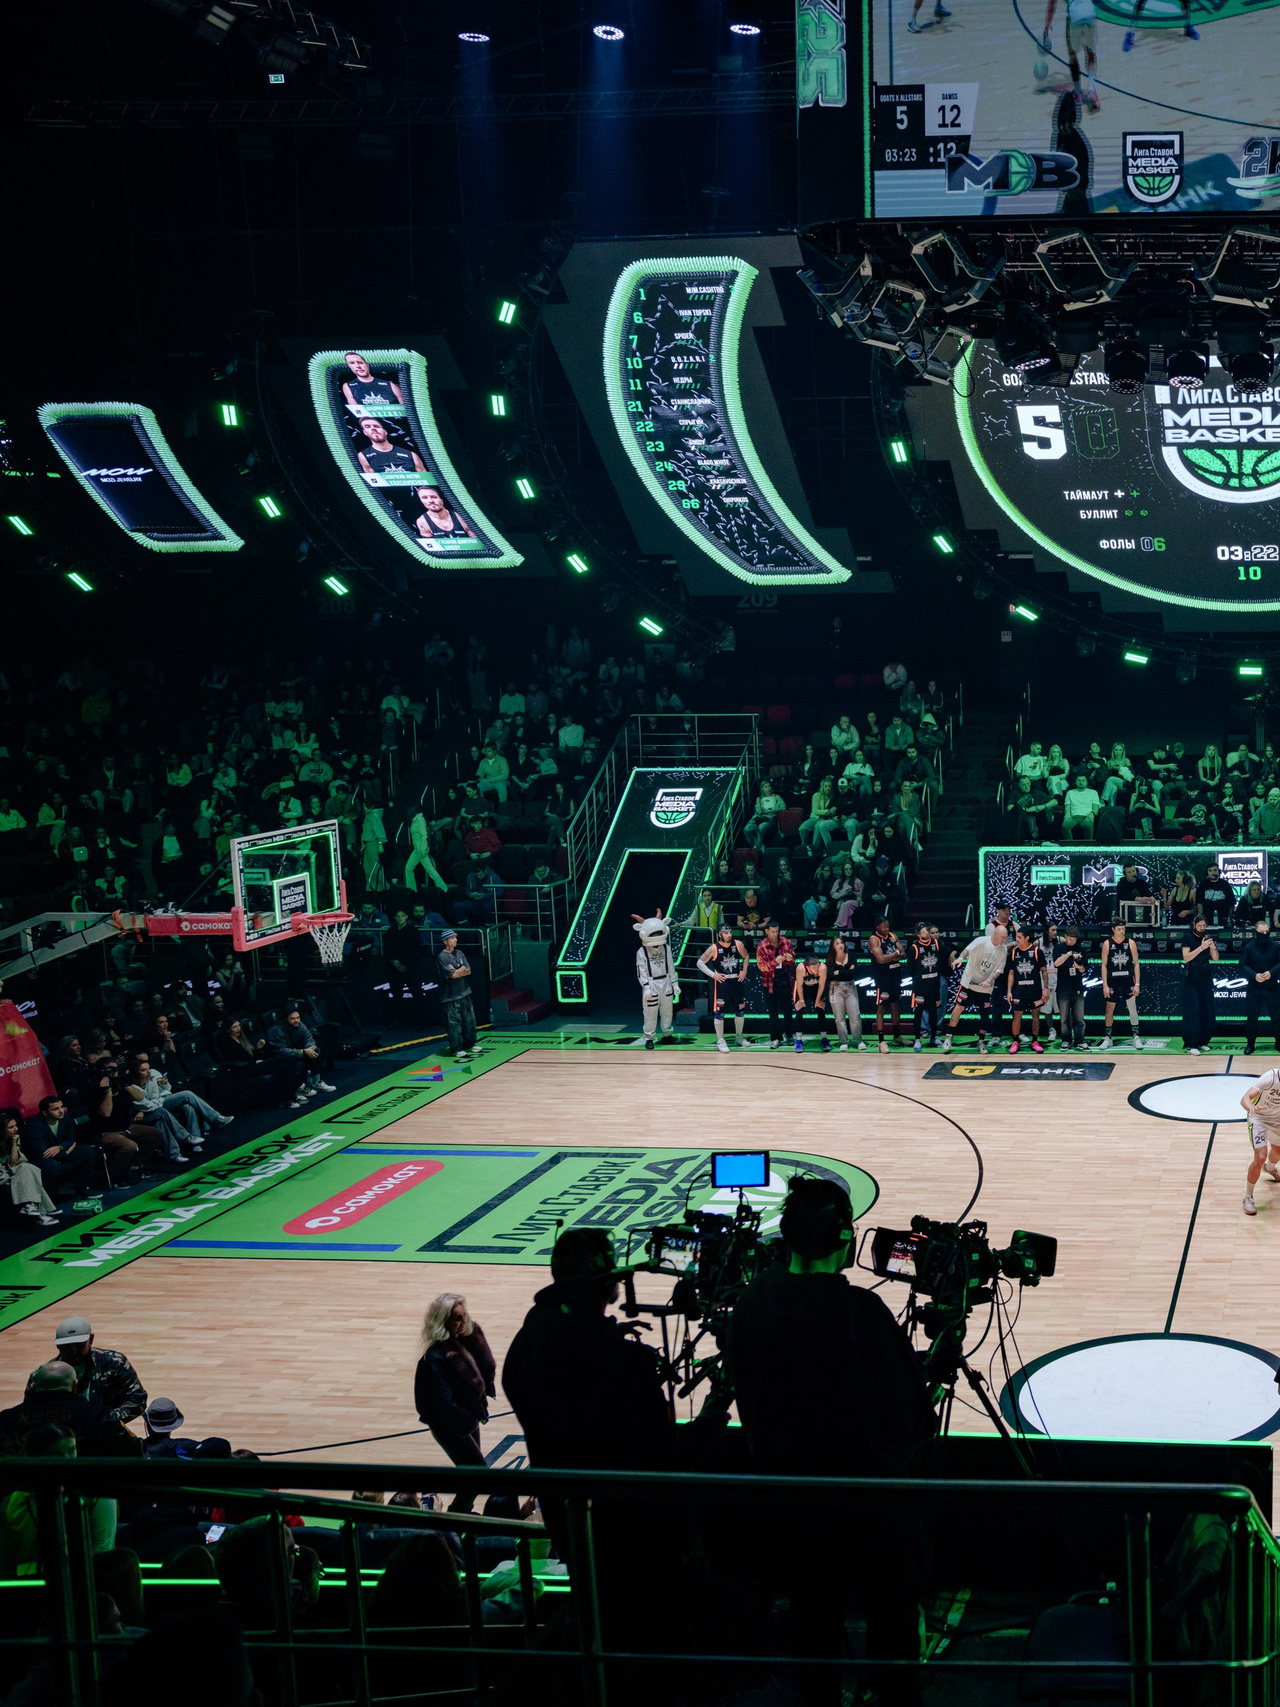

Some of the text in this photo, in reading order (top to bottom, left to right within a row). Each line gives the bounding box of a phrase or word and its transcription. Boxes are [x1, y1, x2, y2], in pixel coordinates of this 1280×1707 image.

[896, 105, 909, 130] 5
[937, 104, 961, 128] 12
[885, 149, 917, 162] 03:23
[1128, 157, 1178, 167] MEDIA
[1128, 166, 1179, 175] BASKET
[638, 288, 647, 300] 1
[632, 312, 644, 324] 6
[629, 335, 638, 347] 7
[625, 357, 643, 369] 10
[628, 379, 643, 391] 11
[627, 400, 643, 412] 21
[635, 421, 655, 432] 22
[645, 441, 665, 452] 23
[655, 461, 674, 472] 24
[1063, 489, 1109, 501] ТАЙМАУТ
[681, 498, 700, 509] 66
[1079, 507, 1119, 520] БУЛЛИТ
[1099, 536, 1167, 551] ФОЛЫ 06
[1216, 544, 1280, 561] 03:22
[1237, 566, 1262, 580] 10
[1000, 1067, 1086, 1075] БАНК
[29, 1132, 315, 1265] ЛИГА СТАВОК
[62, 1131, 347, 1268] MEDIA BASKET
